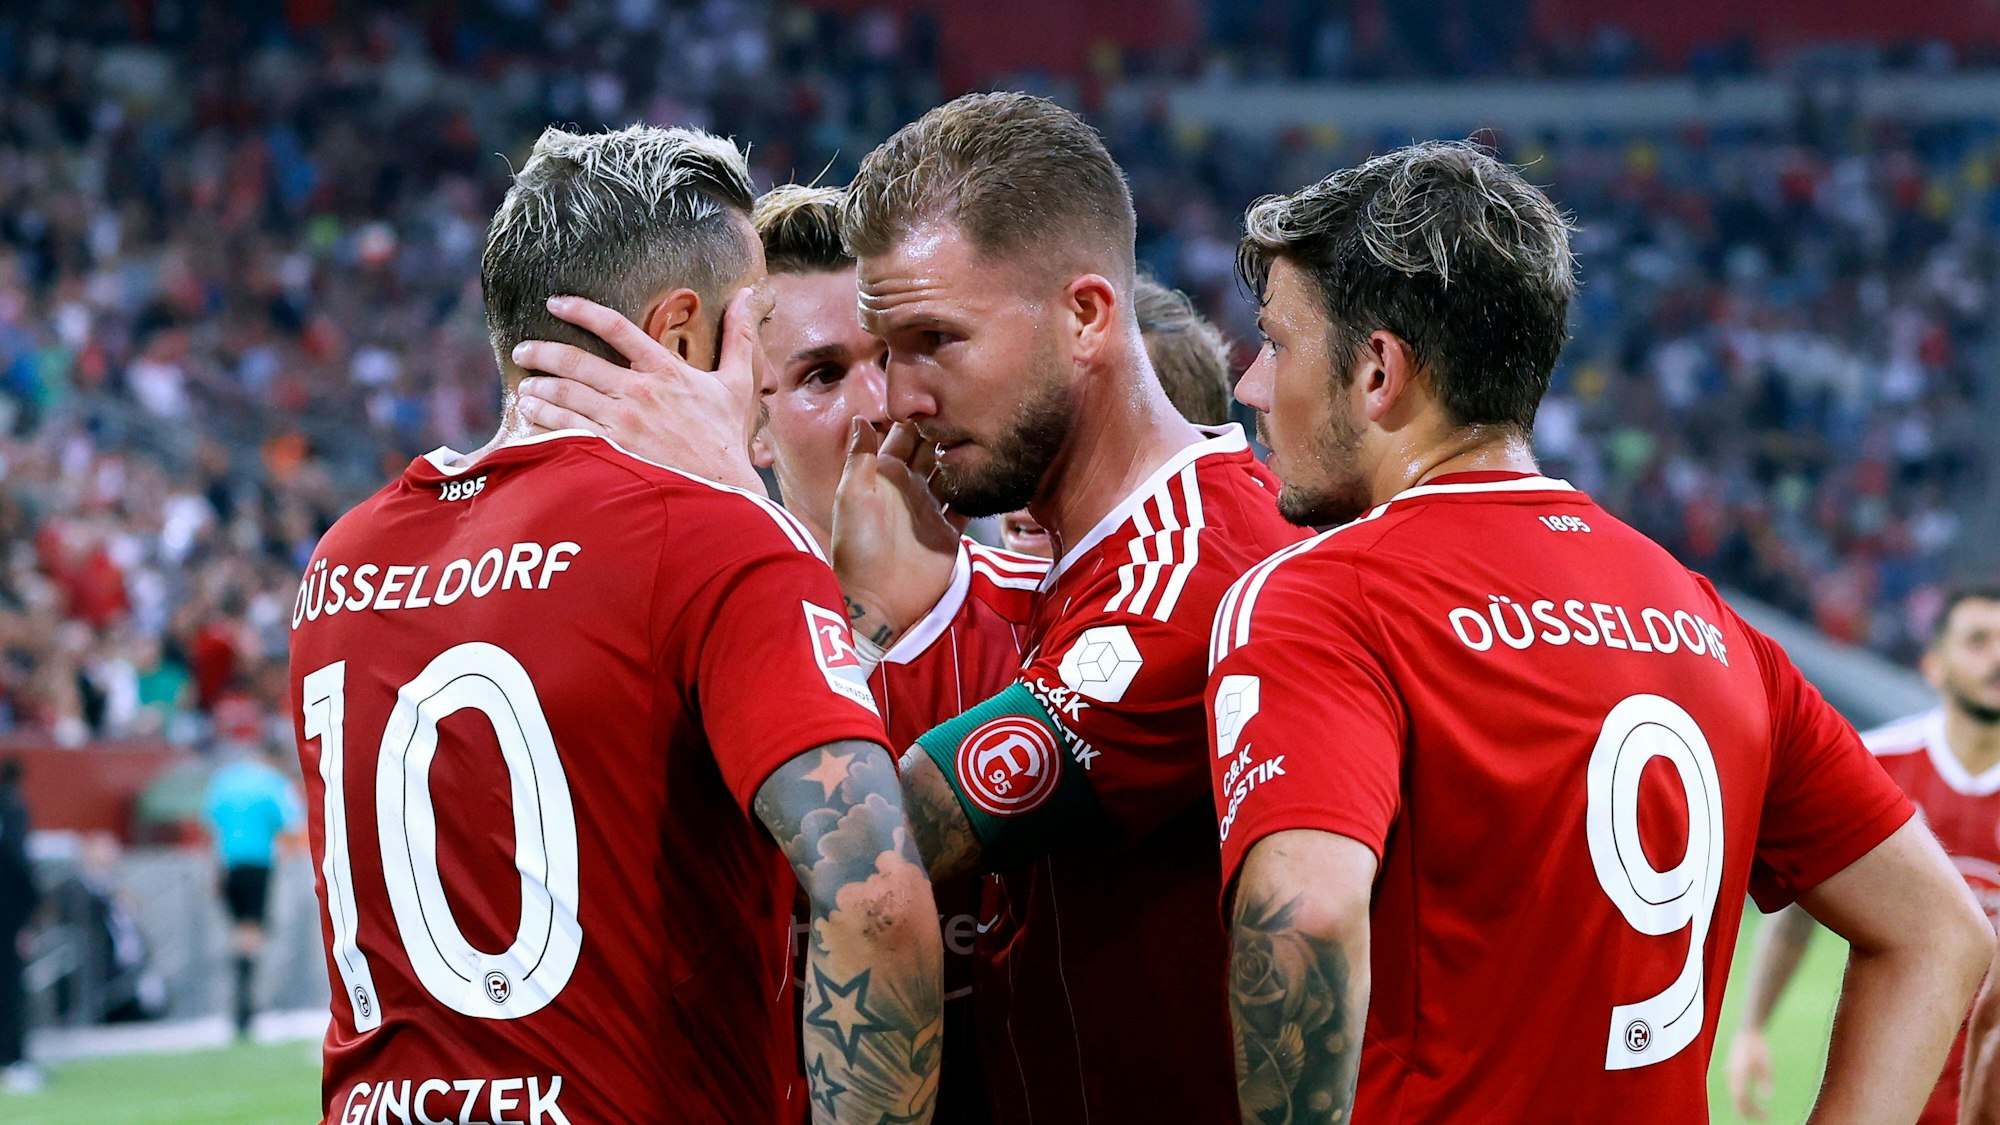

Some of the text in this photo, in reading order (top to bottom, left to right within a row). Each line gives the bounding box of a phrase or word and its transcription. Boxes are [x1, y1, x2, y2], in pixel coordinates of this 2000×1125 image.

[438, 475, 488, 502] 1895
[1537, 514, 1592, 533] 1895
[291, 541, 582, 631] DÜSSELDORF
[1448, 594, 1729, 668] DÜSSELDORF
[1036, 677, 1091, 723] C&K
[988, 769, 1013, 795] 95
[1223, 743, 1253, 798] C&K
[1219, 754, 1287, 850] OGISTIK
[302, 641, 583, 1034] 10
[1586, 692, 1724, 1071] 9
[340, 1075, 573, 1125] GINCZEK
